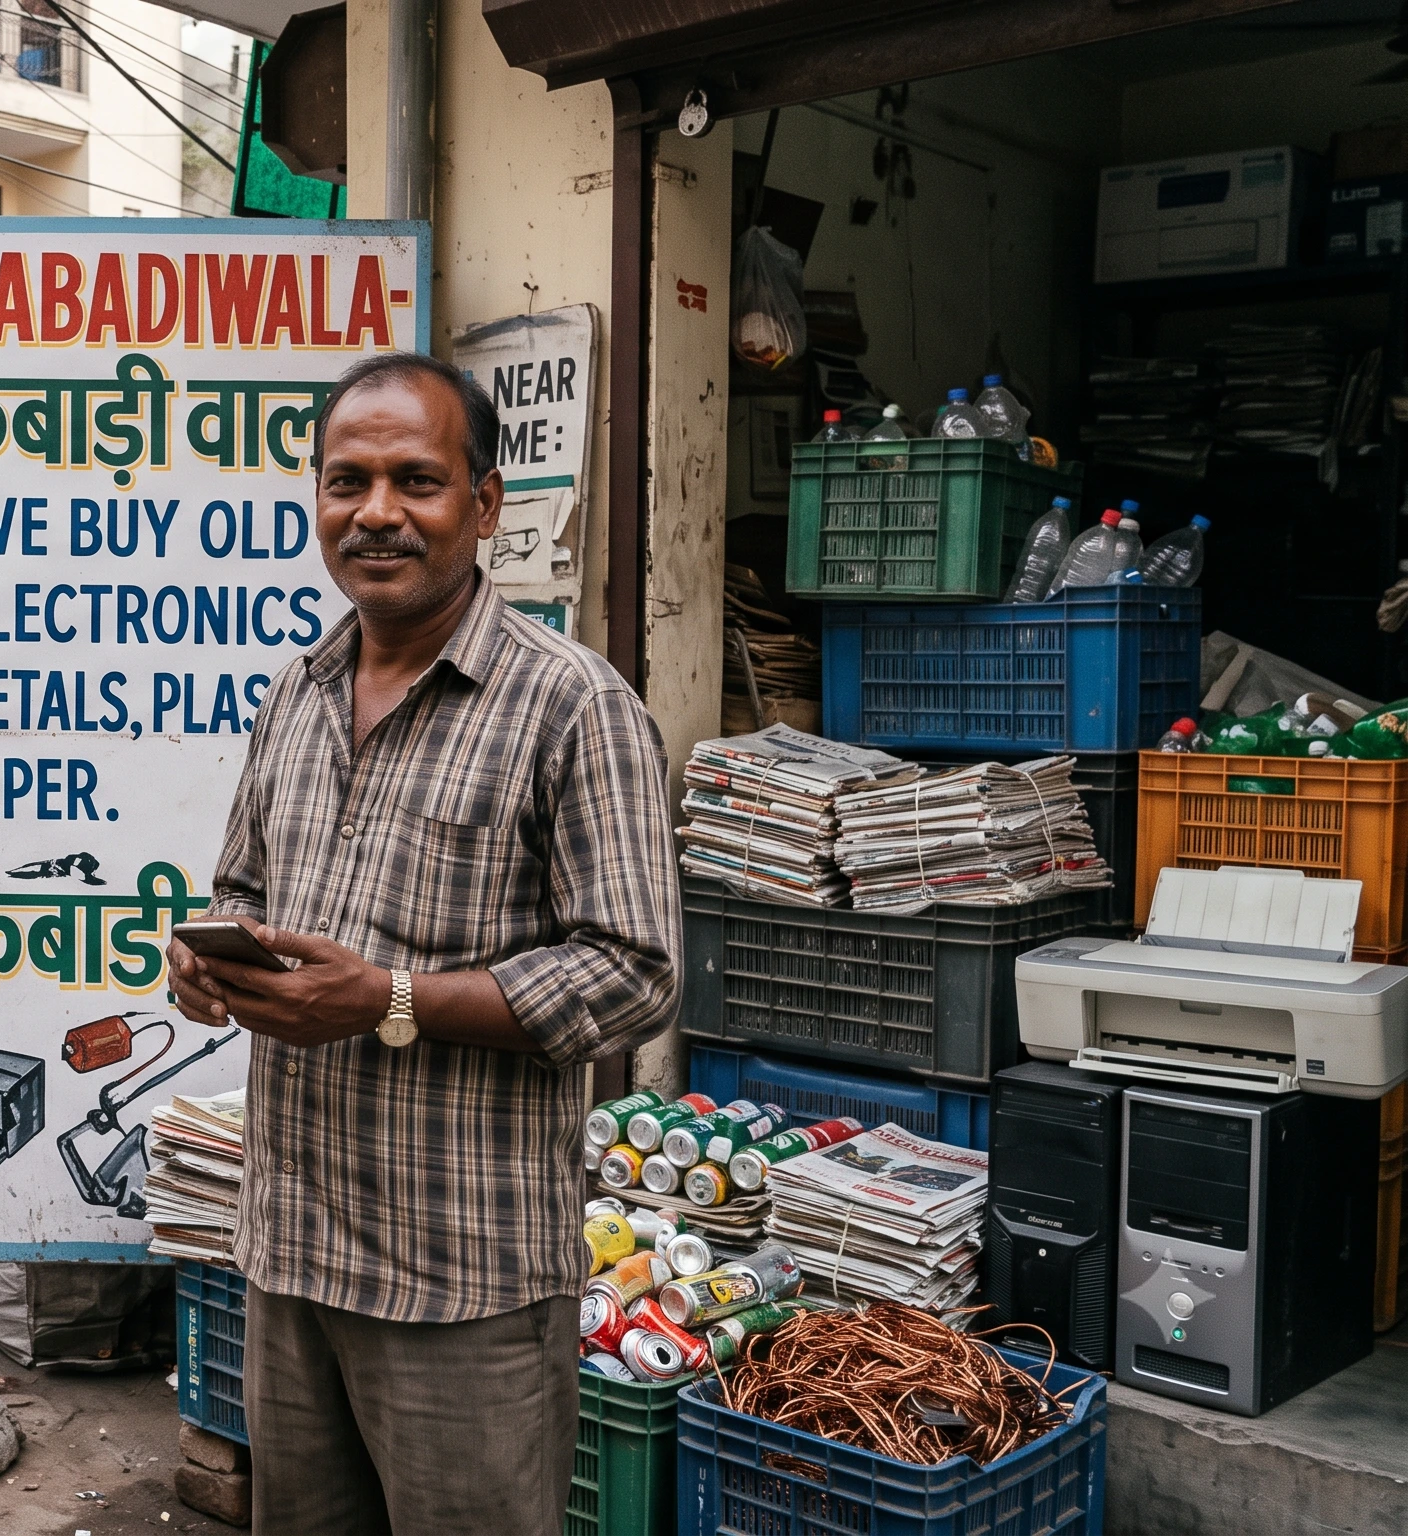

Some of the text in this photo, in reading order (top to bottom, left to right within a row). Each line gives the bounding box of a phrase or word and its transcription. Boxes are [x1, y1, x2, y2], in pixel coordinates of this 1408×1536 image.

[494, 357, 576, 411] NEAR
[499, 418, 564, 466] ME:
[71, 499, 179, 557] BUY
[200, 500, 309, 559] OLD
